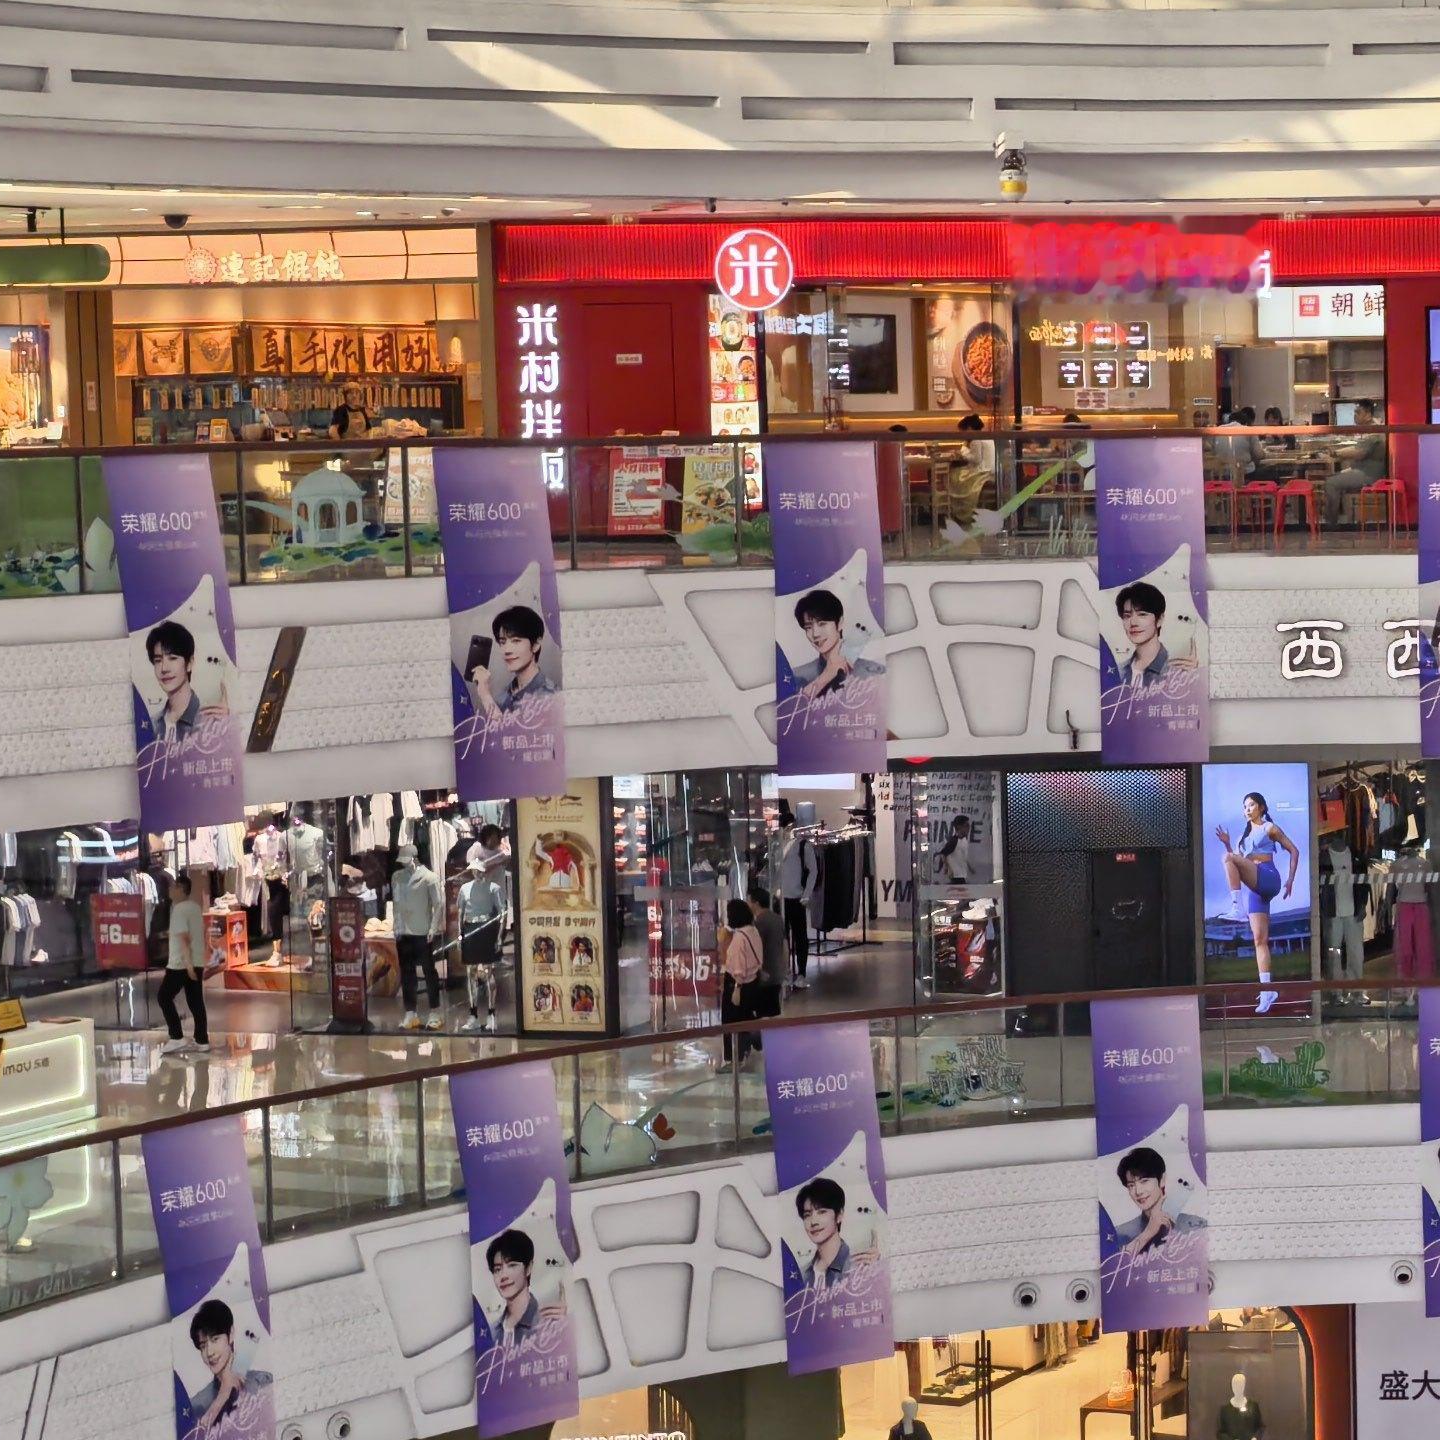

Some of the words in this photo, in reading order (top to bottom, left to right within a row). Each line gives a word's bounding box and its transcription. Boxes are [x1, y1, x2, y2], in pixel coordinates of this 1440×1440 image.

[778, 490, 852, 513] 荣耀600
[1105, 485, 1178, 507] 荣耀600
[121, 509, 192, 535] 荣耀600
[449, 500, 522, 524] 荣耀600
